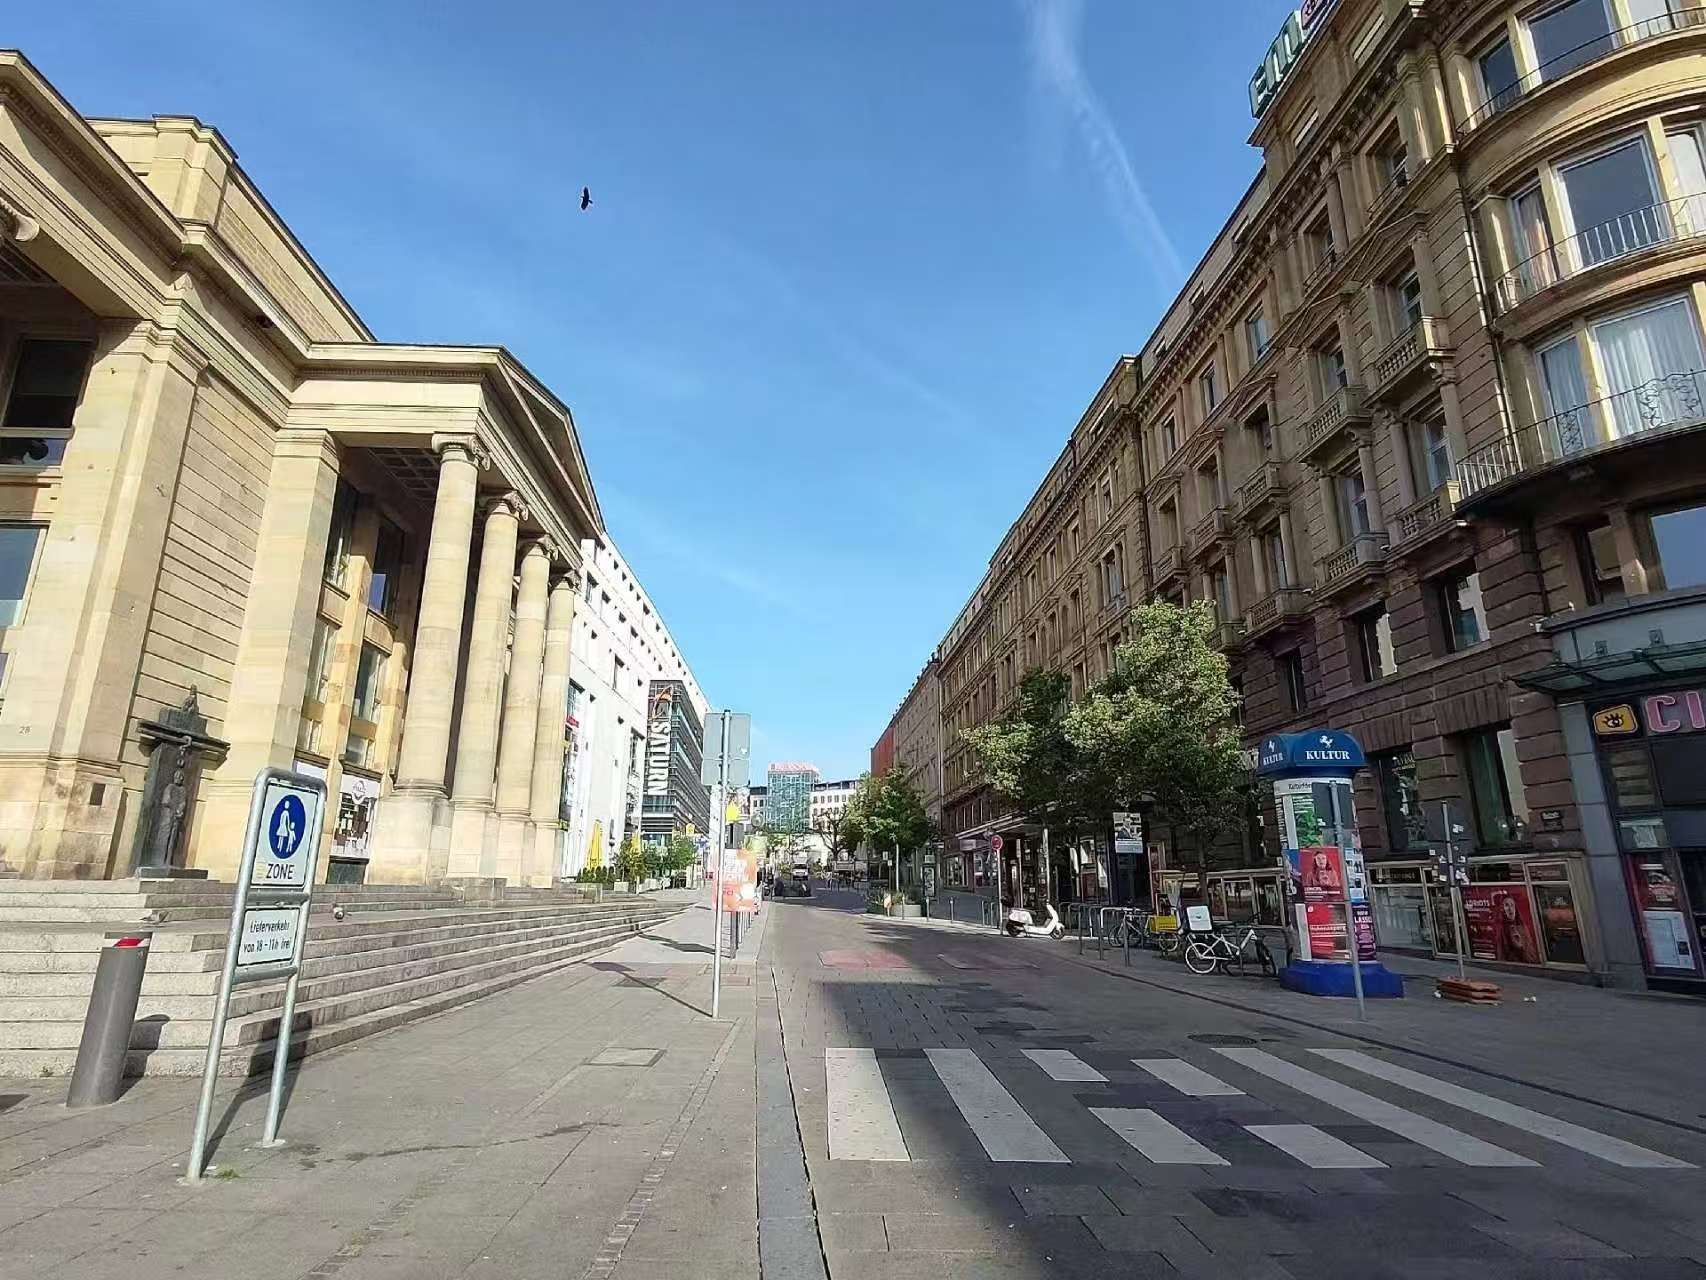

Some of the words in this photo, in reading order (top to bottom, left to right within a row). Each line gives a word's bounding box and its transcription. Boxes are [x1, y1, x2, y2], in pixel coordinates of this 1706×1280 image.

[648, 721, 671, 796] SATURN
[1306, 749, 1351, 760] KULTUR
[266, 863, 295, 880] ZONE
[250, 920, 290, 933] Lieferverkehr
[243, 943, 255, 953] von
